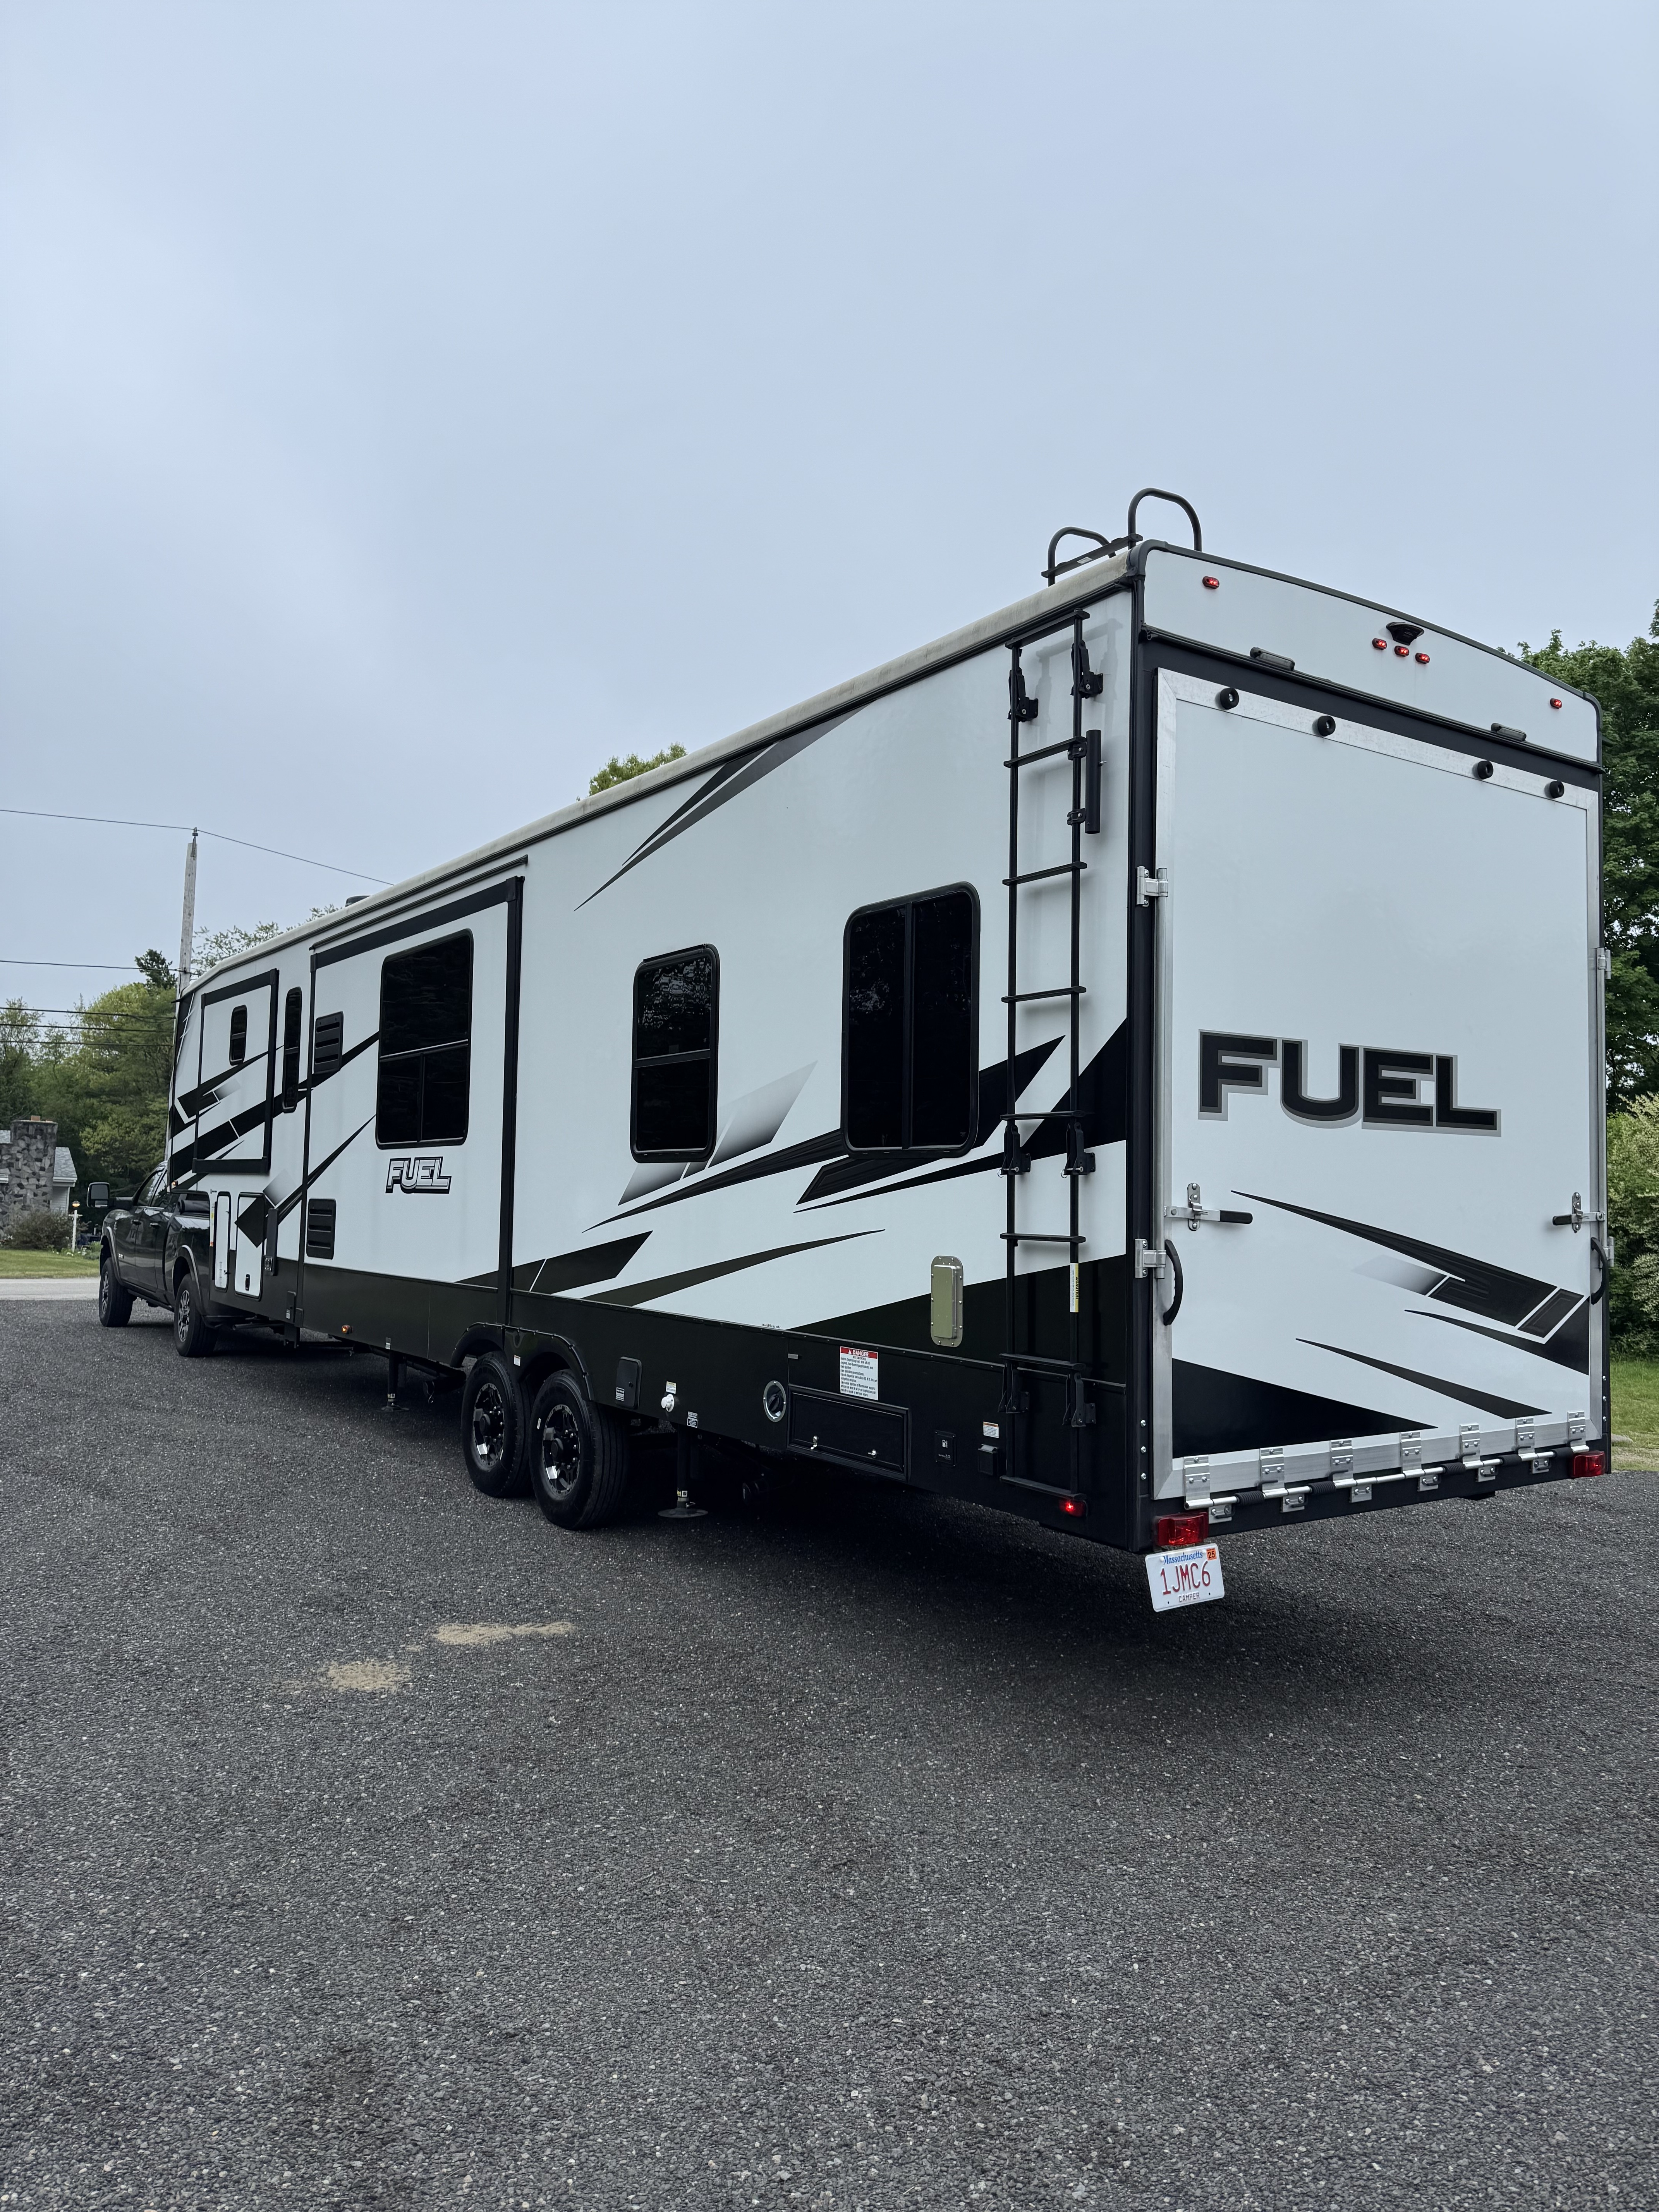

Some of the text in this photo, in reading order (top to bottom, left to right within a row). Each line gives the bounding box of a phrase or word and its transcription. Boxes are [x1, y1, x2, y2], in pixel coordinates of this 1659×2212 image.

[1198, 1029, 1501, 1136] FUEL
[386, 1157, 452, 1194] FUEL
[1163, 1551, 1215, 1565] Massachusetts 25
[1160, 1561, 1211, 1595] 1JMC6
[1178, 1592, 1200, 1602] CAMPER
